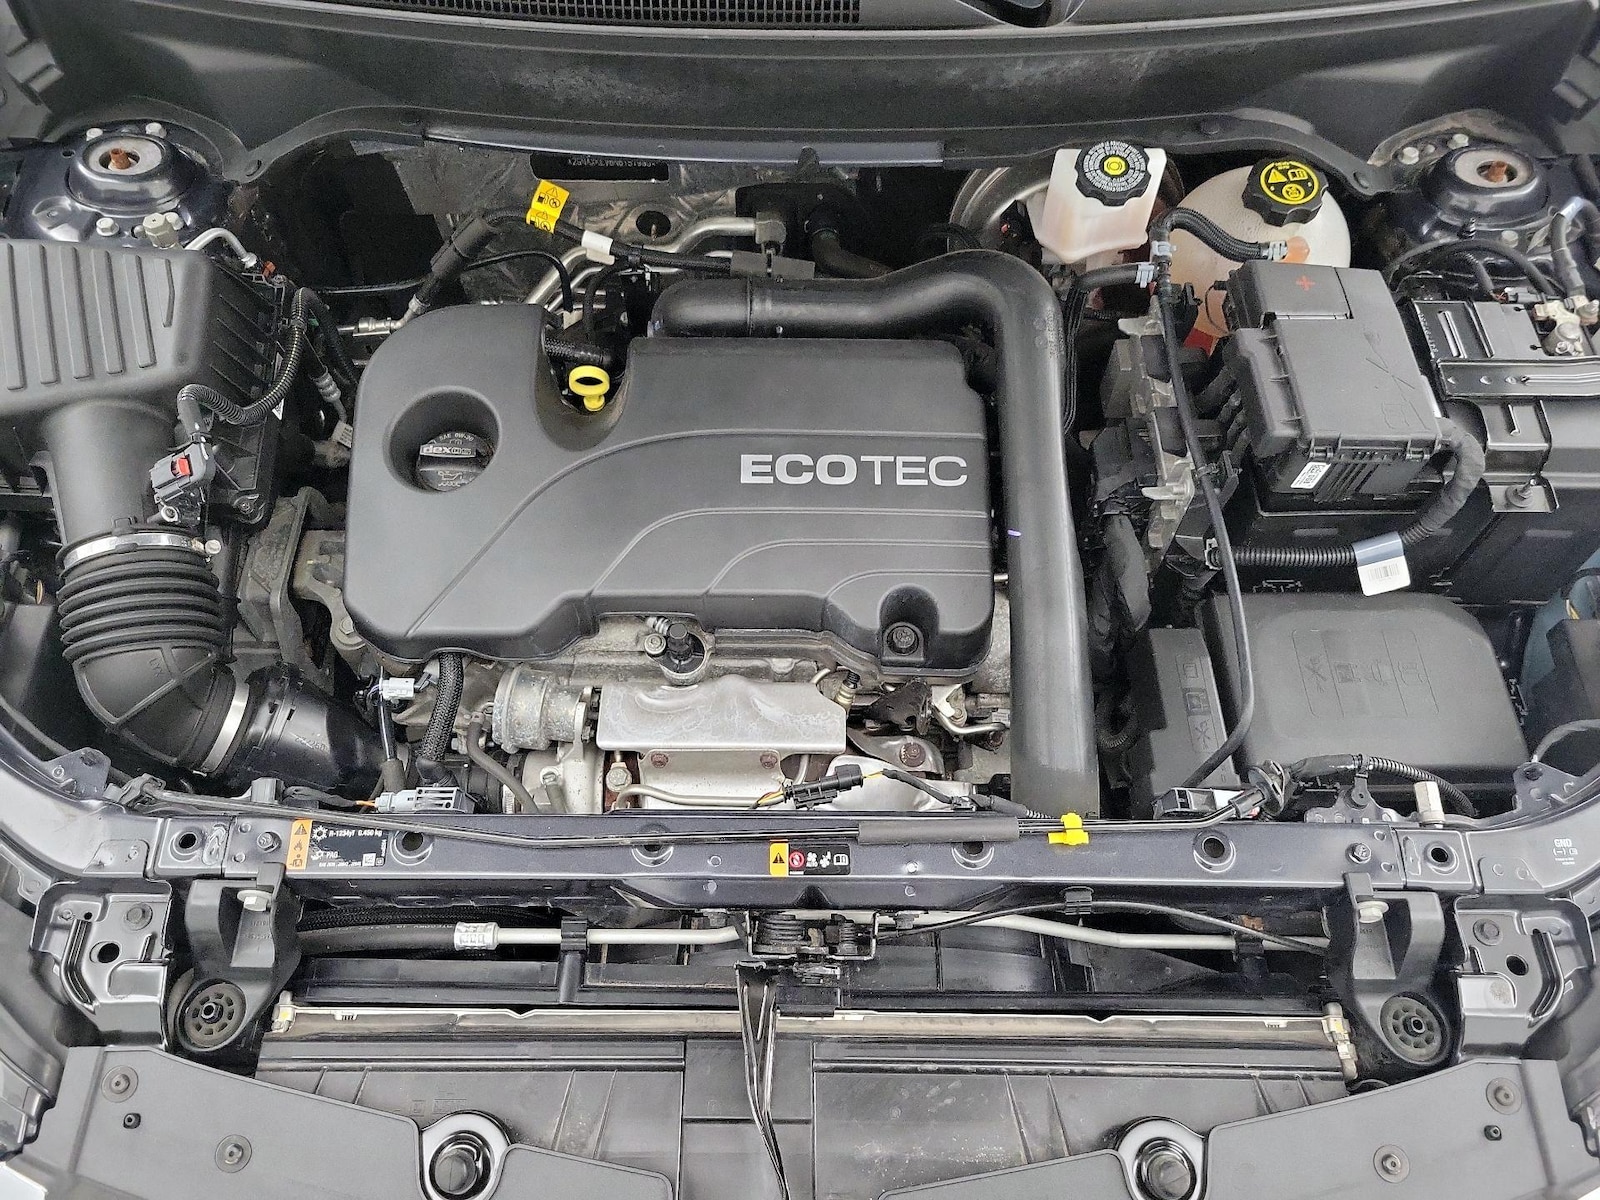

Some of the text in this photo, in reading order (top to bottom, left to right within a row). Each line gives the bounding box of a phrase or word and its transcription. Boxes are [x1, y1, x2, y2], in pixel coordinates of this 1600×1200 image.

[740, 453, 968, 487] ECOTEC
[1553, 838, 1573, 848] GND
[326, 851, 339, 859] PAG
